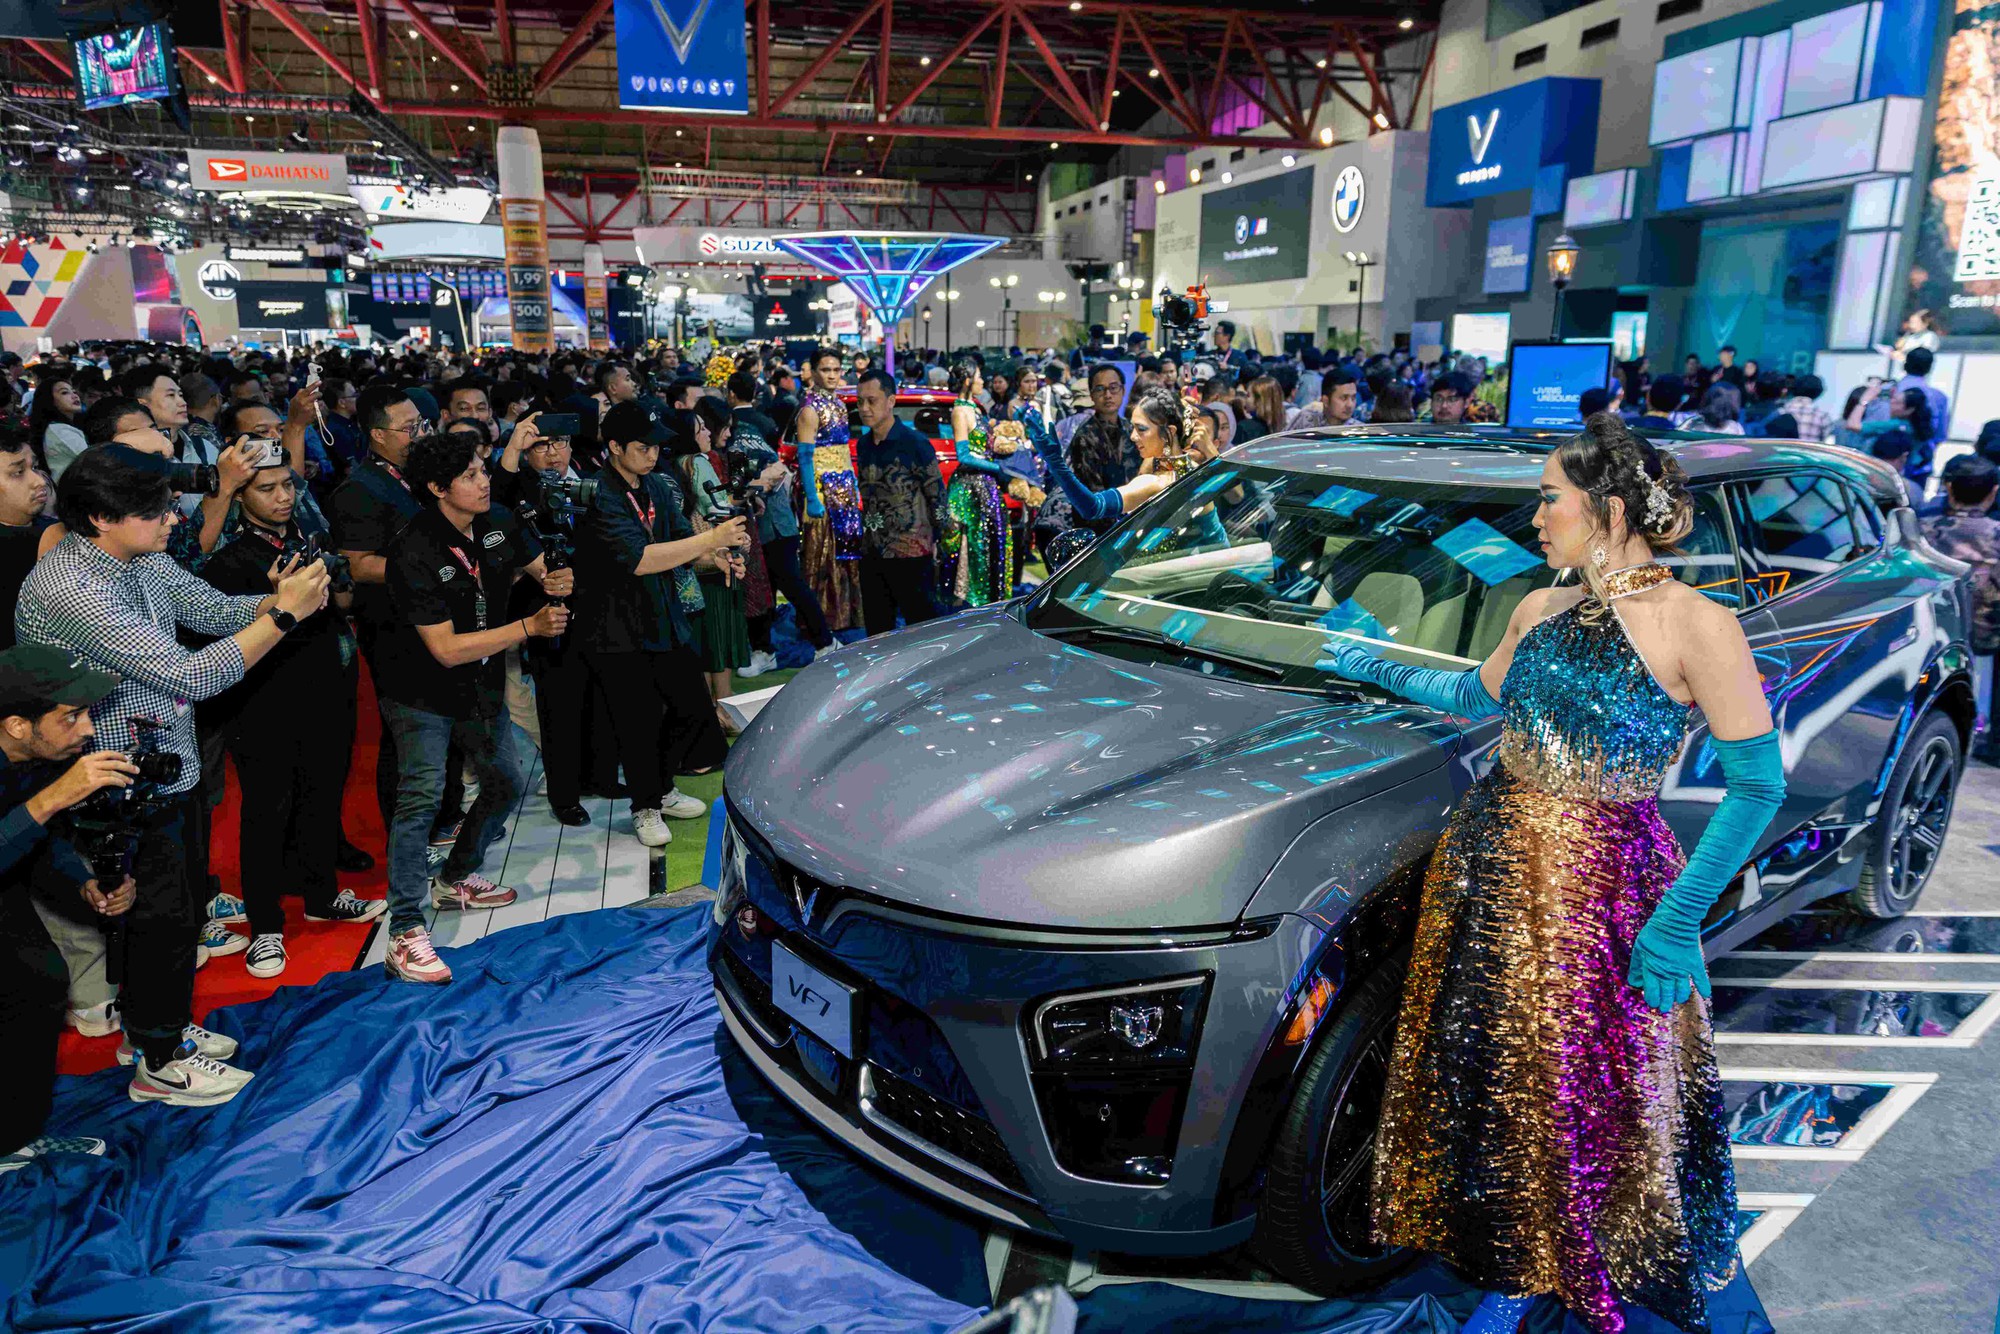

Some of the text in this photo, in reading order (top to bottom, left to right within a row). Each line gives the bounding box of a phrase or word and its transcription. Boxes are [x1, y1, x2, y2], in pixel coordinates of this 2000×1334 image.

[631, 75, 735, 97] VINFAST
[251, 165, 329, 180] DAIHATSU
[723, 239, 779, 253] SUZU
[1949, 294, 1980, 308] Scan
[788, 975, 831, 1017] VF7
